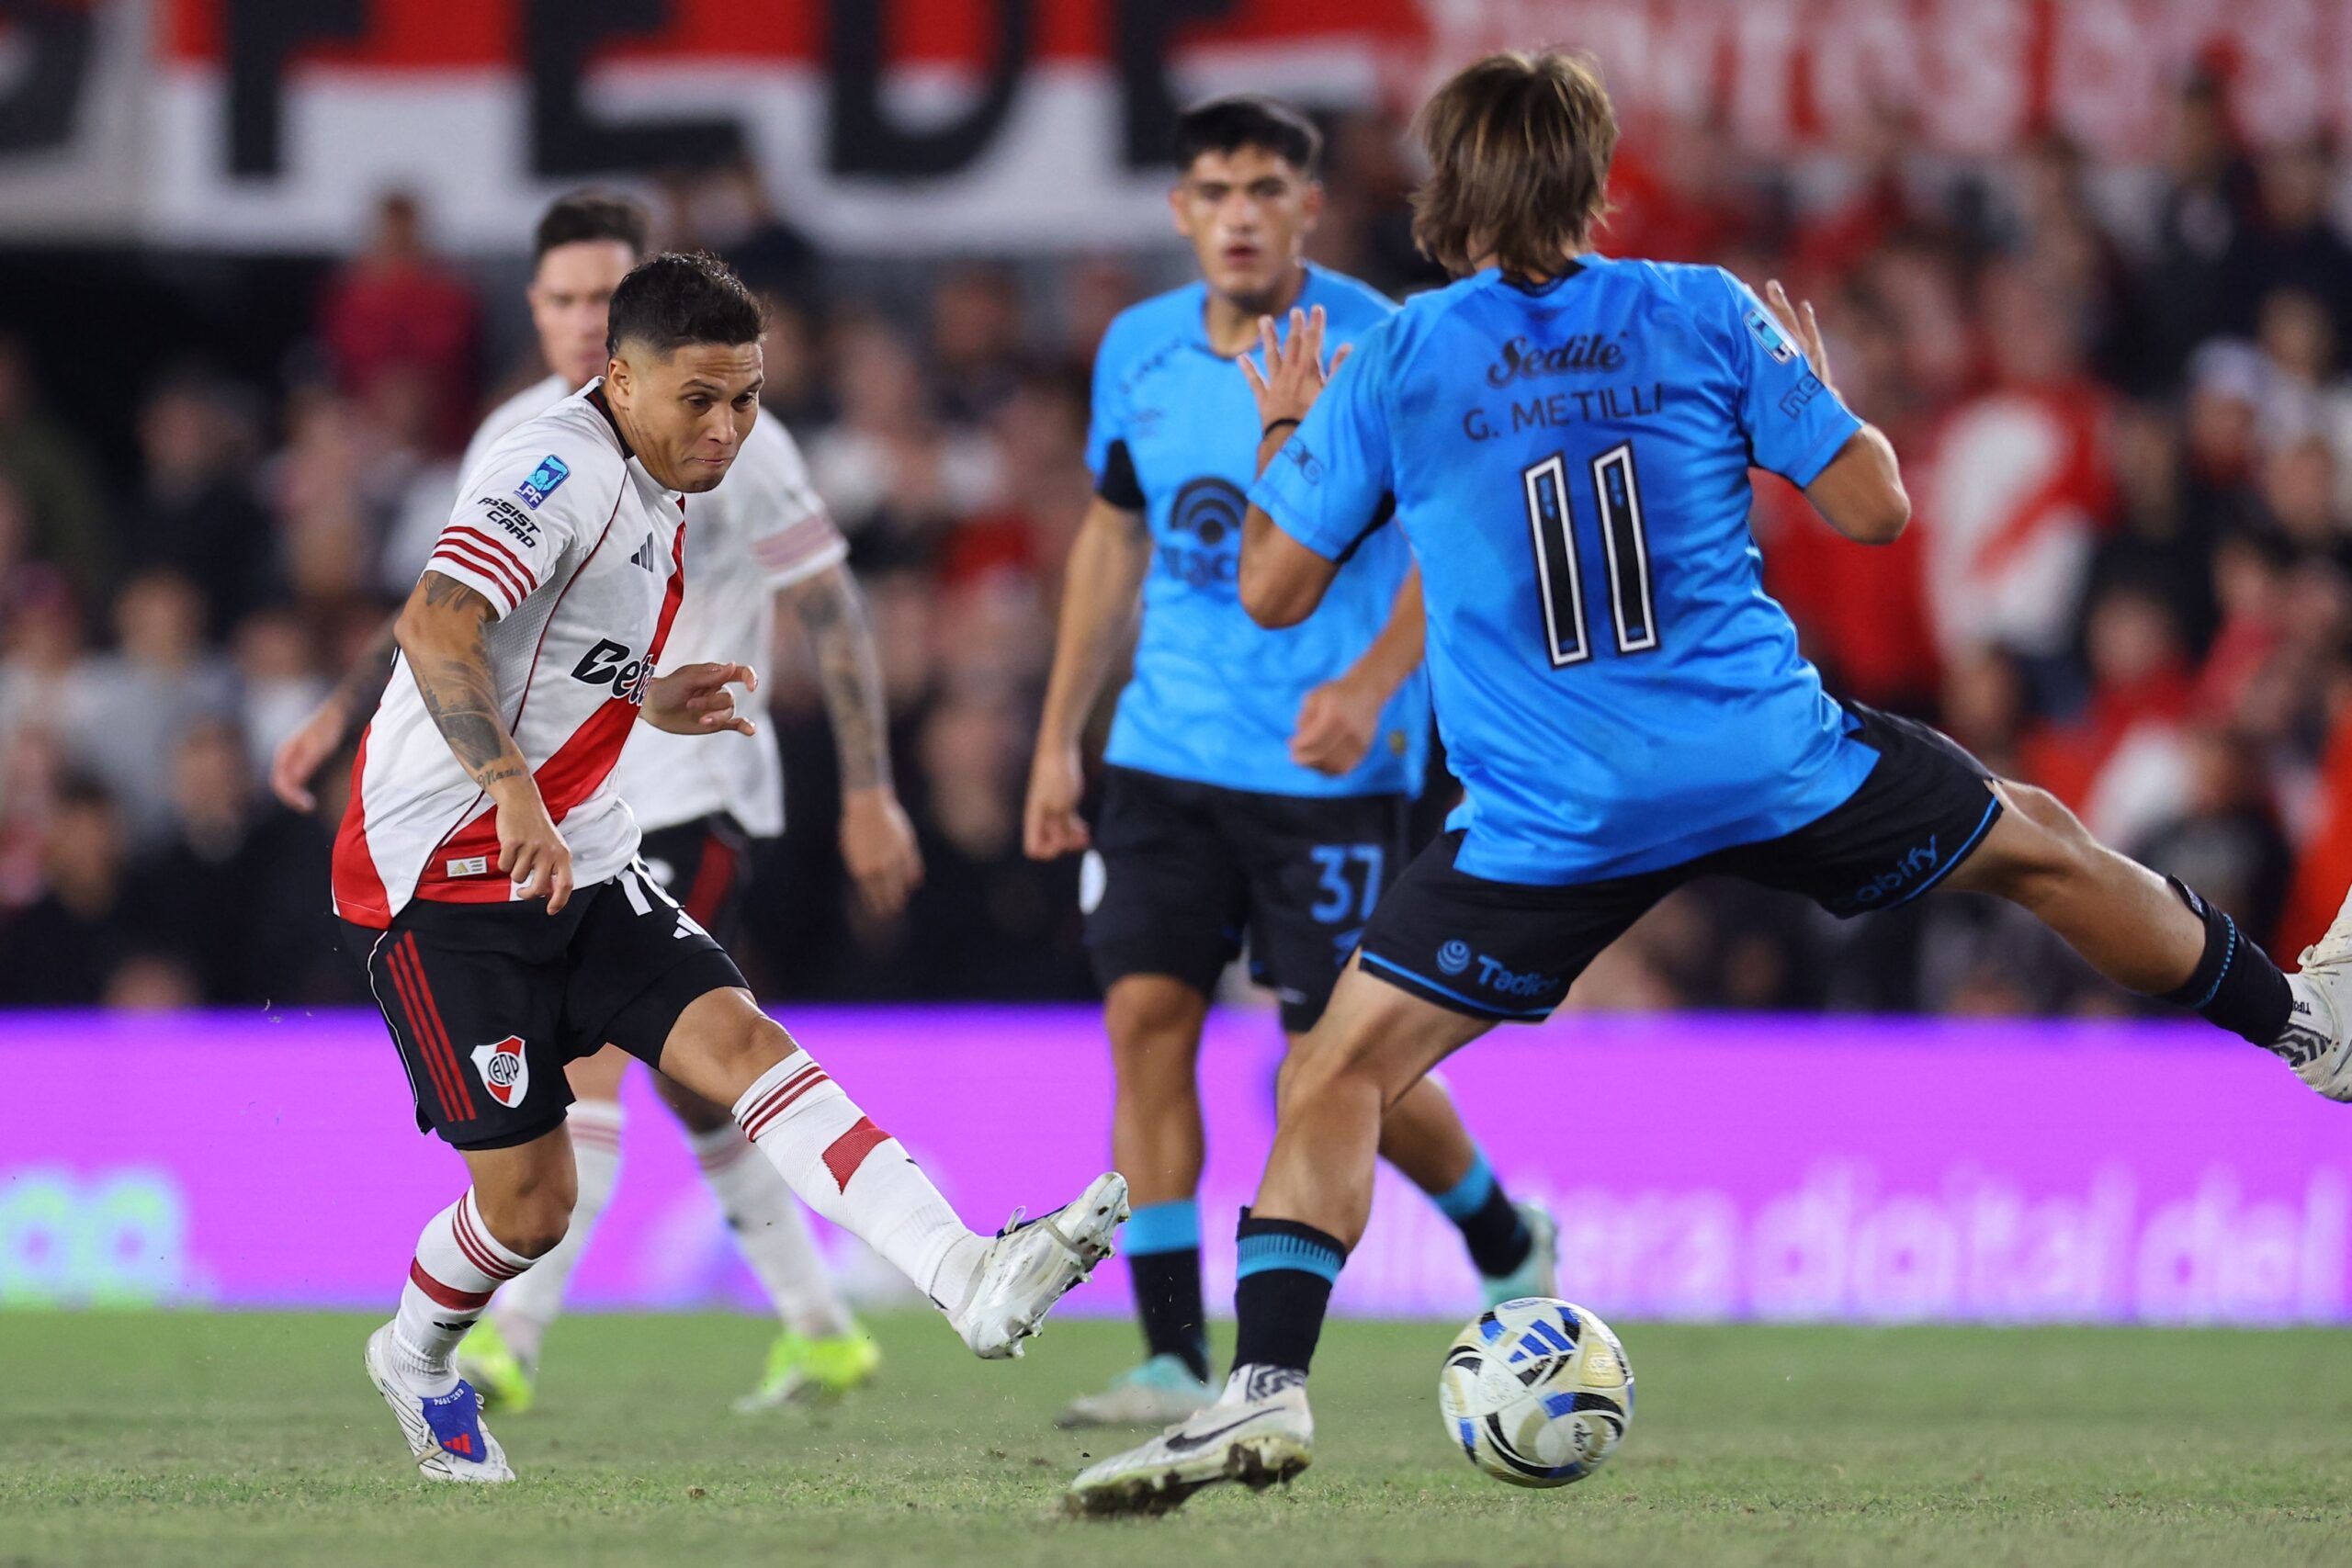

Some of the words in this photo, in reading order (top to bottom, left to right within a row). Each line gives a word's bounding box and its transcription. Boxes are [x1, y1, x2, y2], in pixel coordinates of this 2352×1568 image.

[1462, 408, 1500, 441] G.
[1510, 381, 1662, 434] METILLI
[486, 510, 536, 549] CARD
[1521, 439, 1661, 671] 11
[1309, 844, 1385, 924] 37
